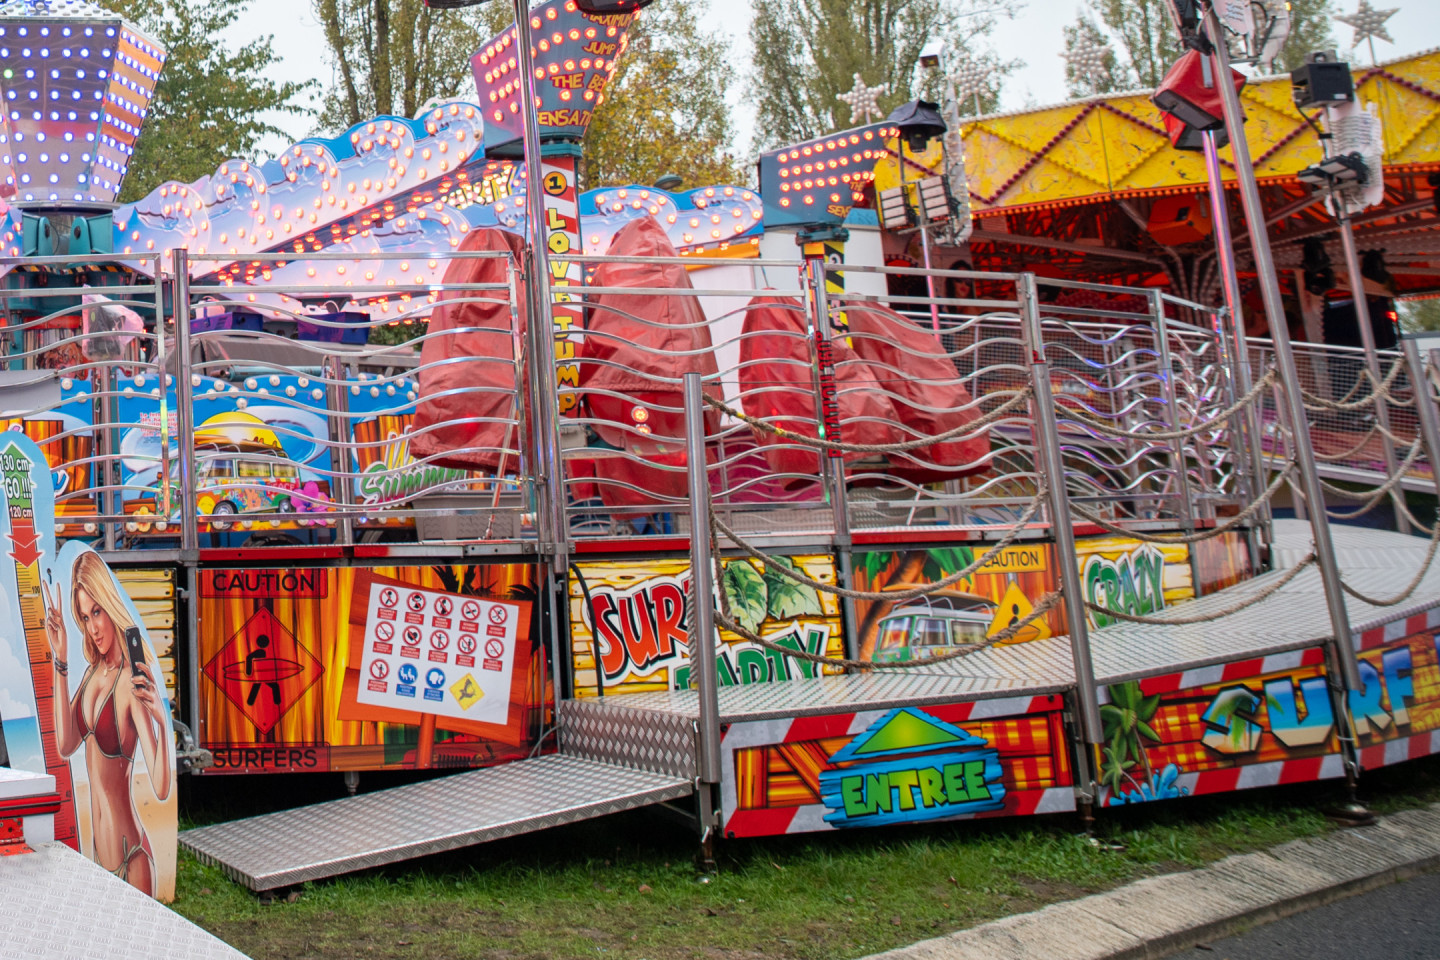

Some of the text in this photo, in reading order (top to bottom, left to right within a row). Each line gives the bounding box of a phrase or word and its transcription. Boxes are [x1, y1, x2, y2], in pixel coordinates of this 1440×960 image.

[582, 41, 617, 55] JUMP
[550, 72, 585, 89] THE
[550, 176, 563, 191] 1
[554, 317, 579, 417] JUMP
[0, 454, 30, 472] 130 cm
[5, 477, 20, 499] GO
[9, 506, 33, 518] 120 cm
[982, 551, 1039, 570] CAUTION
[212, 573, 315, 592] CAUTION
[1086, 546, 1165, 629] CRAZY
[590, 578, 694, 680] SUR
[1199, 643, 1415, 757] SURF
[212, 747, 318, 769] SURFERS
[840, 759, 994, 818] ENTREE
